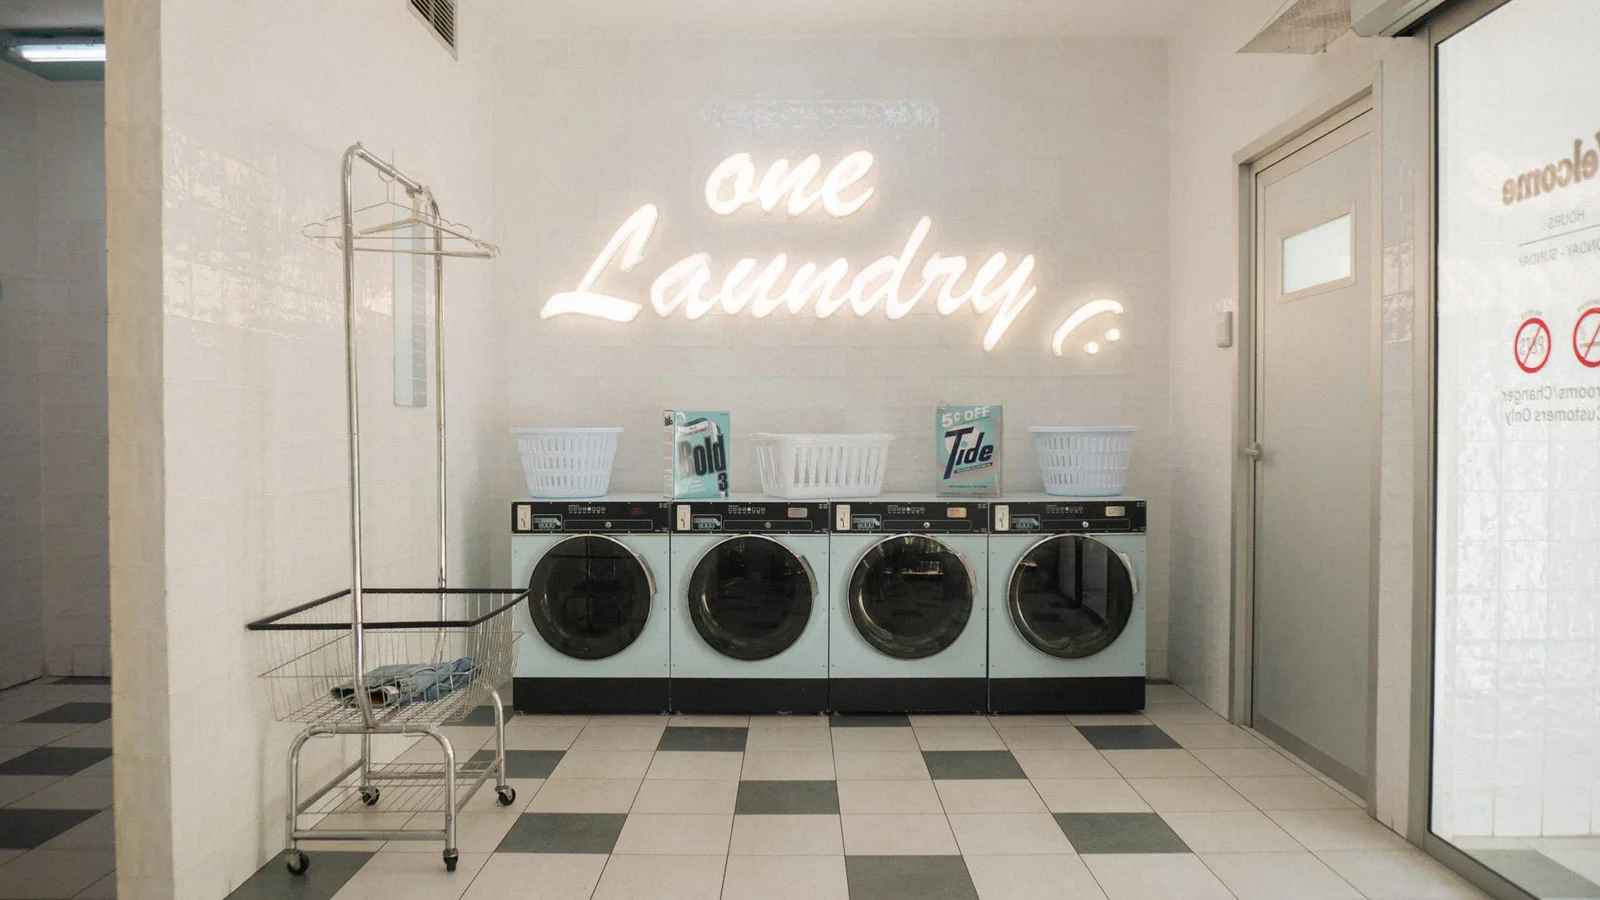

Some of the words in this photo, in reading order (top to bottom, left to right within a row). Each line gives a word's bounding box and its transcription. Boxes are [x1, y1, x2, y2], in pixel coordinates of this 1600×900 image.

[705, 151, 874, 217] one
[540, 203, 1037, 352] Laundry
[964, 406, 990, 421] OFF
[678, 433, 726, 478] Bold
[943, 426, 994, 480] Tide
[717, 471, 728, 491] 3
